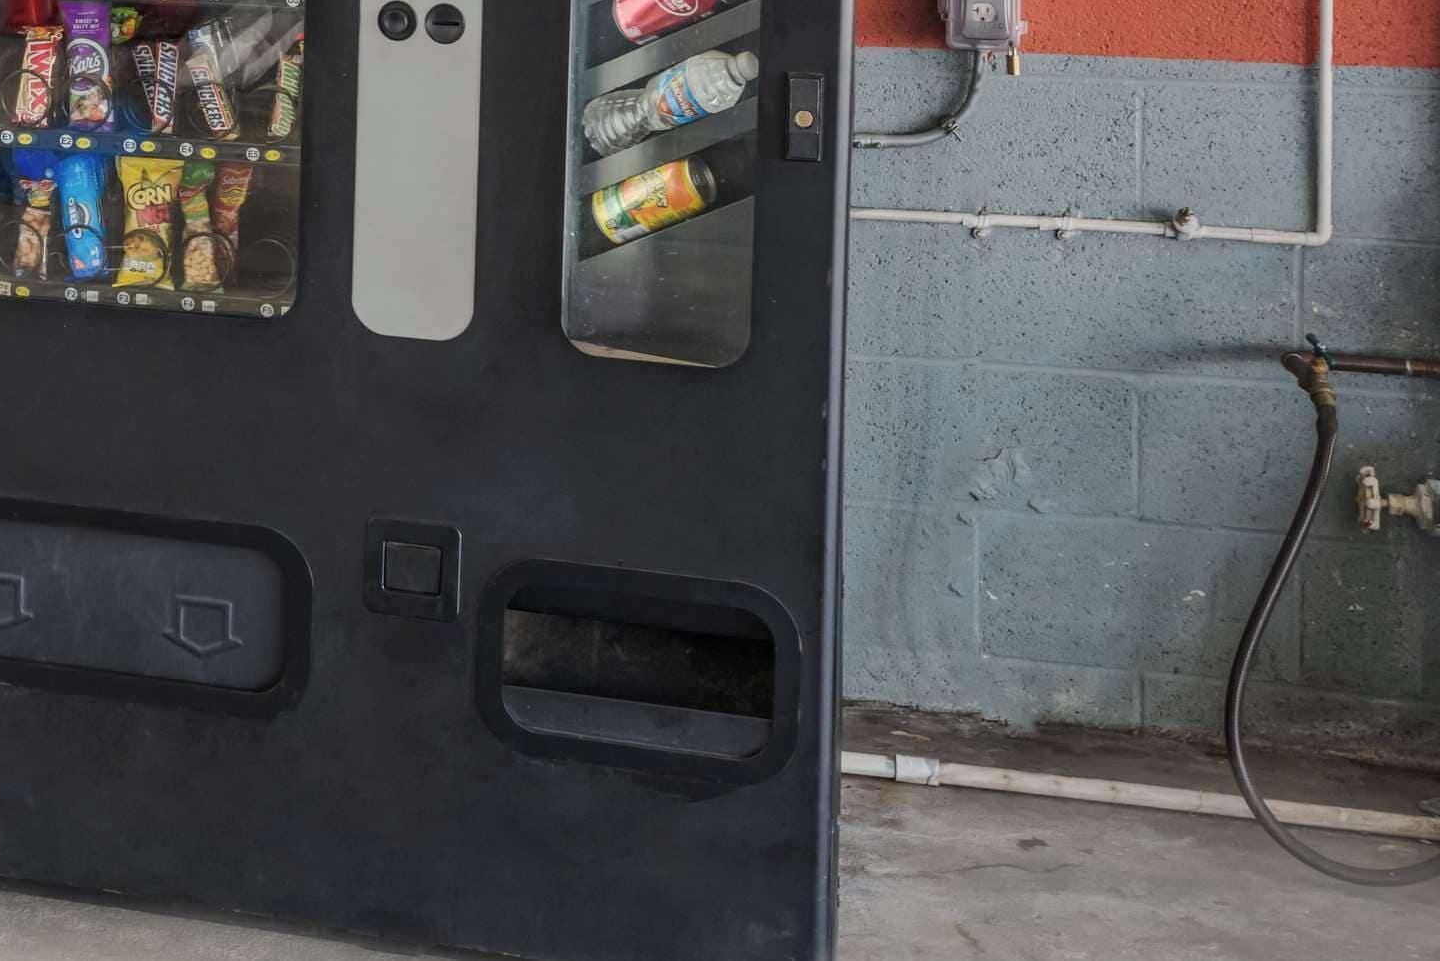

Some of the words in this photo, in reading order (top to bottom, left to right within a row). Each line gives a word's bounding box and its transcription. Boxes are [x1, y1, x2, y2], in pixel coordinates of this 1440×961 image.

[155, 41, 178, 122] SNICKERS
[2, 133, 13, 141] E1
[61, 136, 72, 145] E2
[125, 141, 136, 150] E3
[181, 145, 192, 154] E4
[247, 149, 259, 158] E5
[127, 181, 172, 211] CORN
[66, 290, 77, 299] F2
[118, 293, 129, 303] F3
[183, 299, 193, 309] F4
[262, 306, 273, 315] F5
